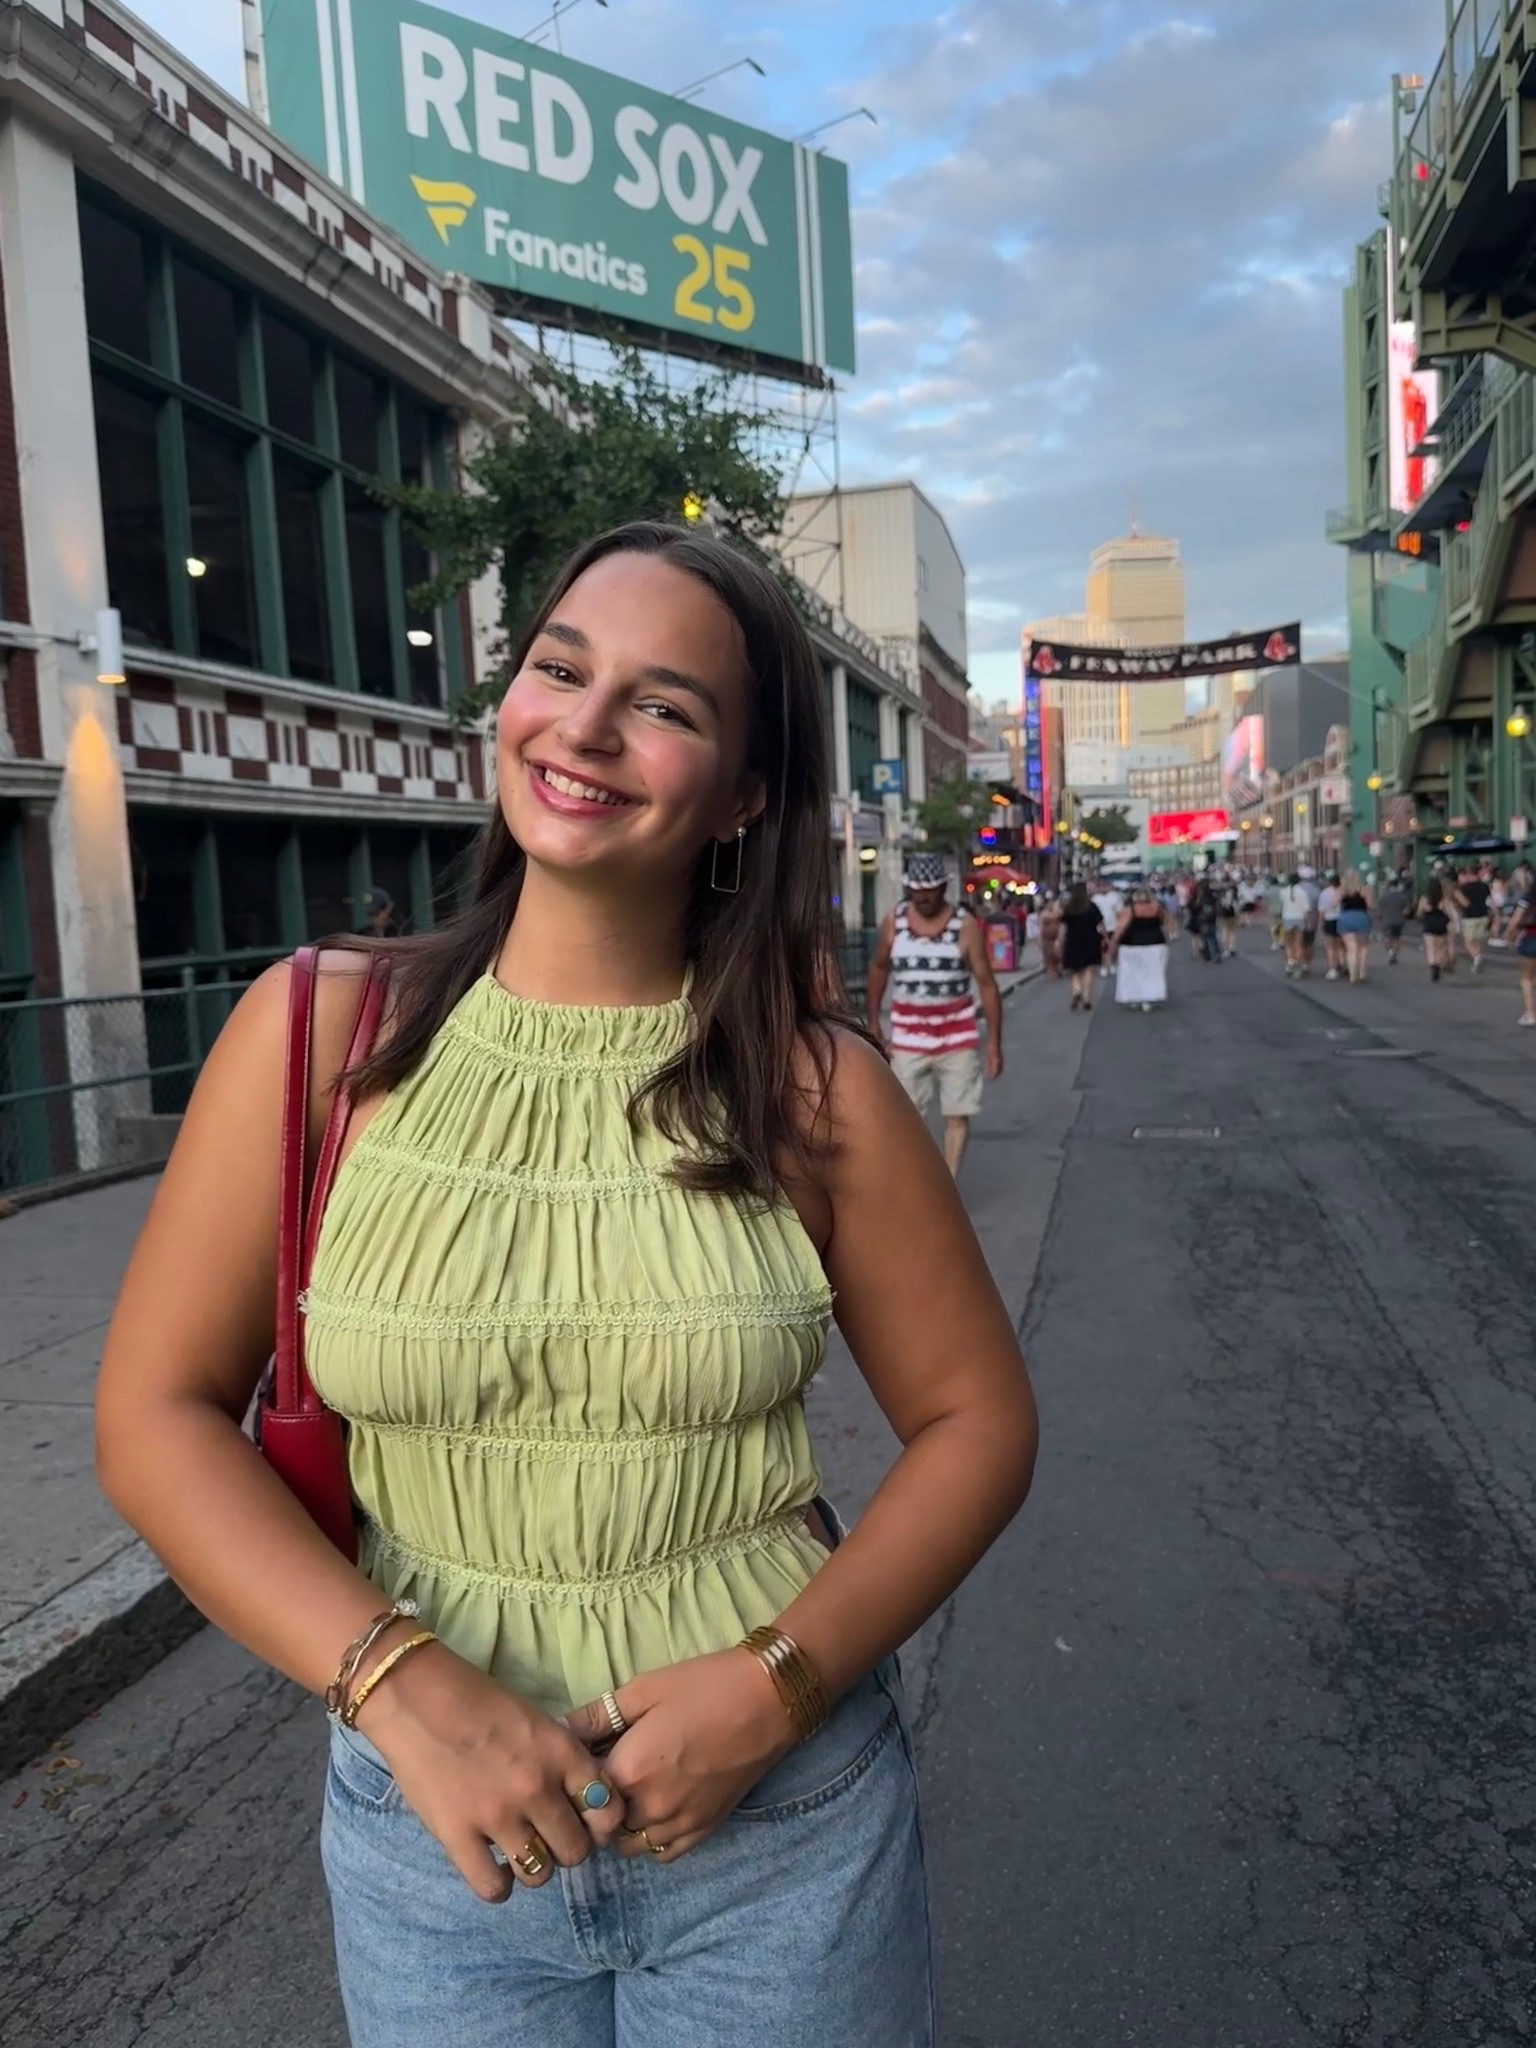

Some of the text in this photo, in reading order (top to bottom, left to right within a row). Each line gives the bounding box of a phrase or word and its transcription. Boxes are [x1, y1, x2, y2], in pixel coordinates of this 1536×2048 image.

[399, 21, 769, 247] RED SOX
[483, 207, 647, 296] Fanatics
[672, 235, 755, 332] 25
